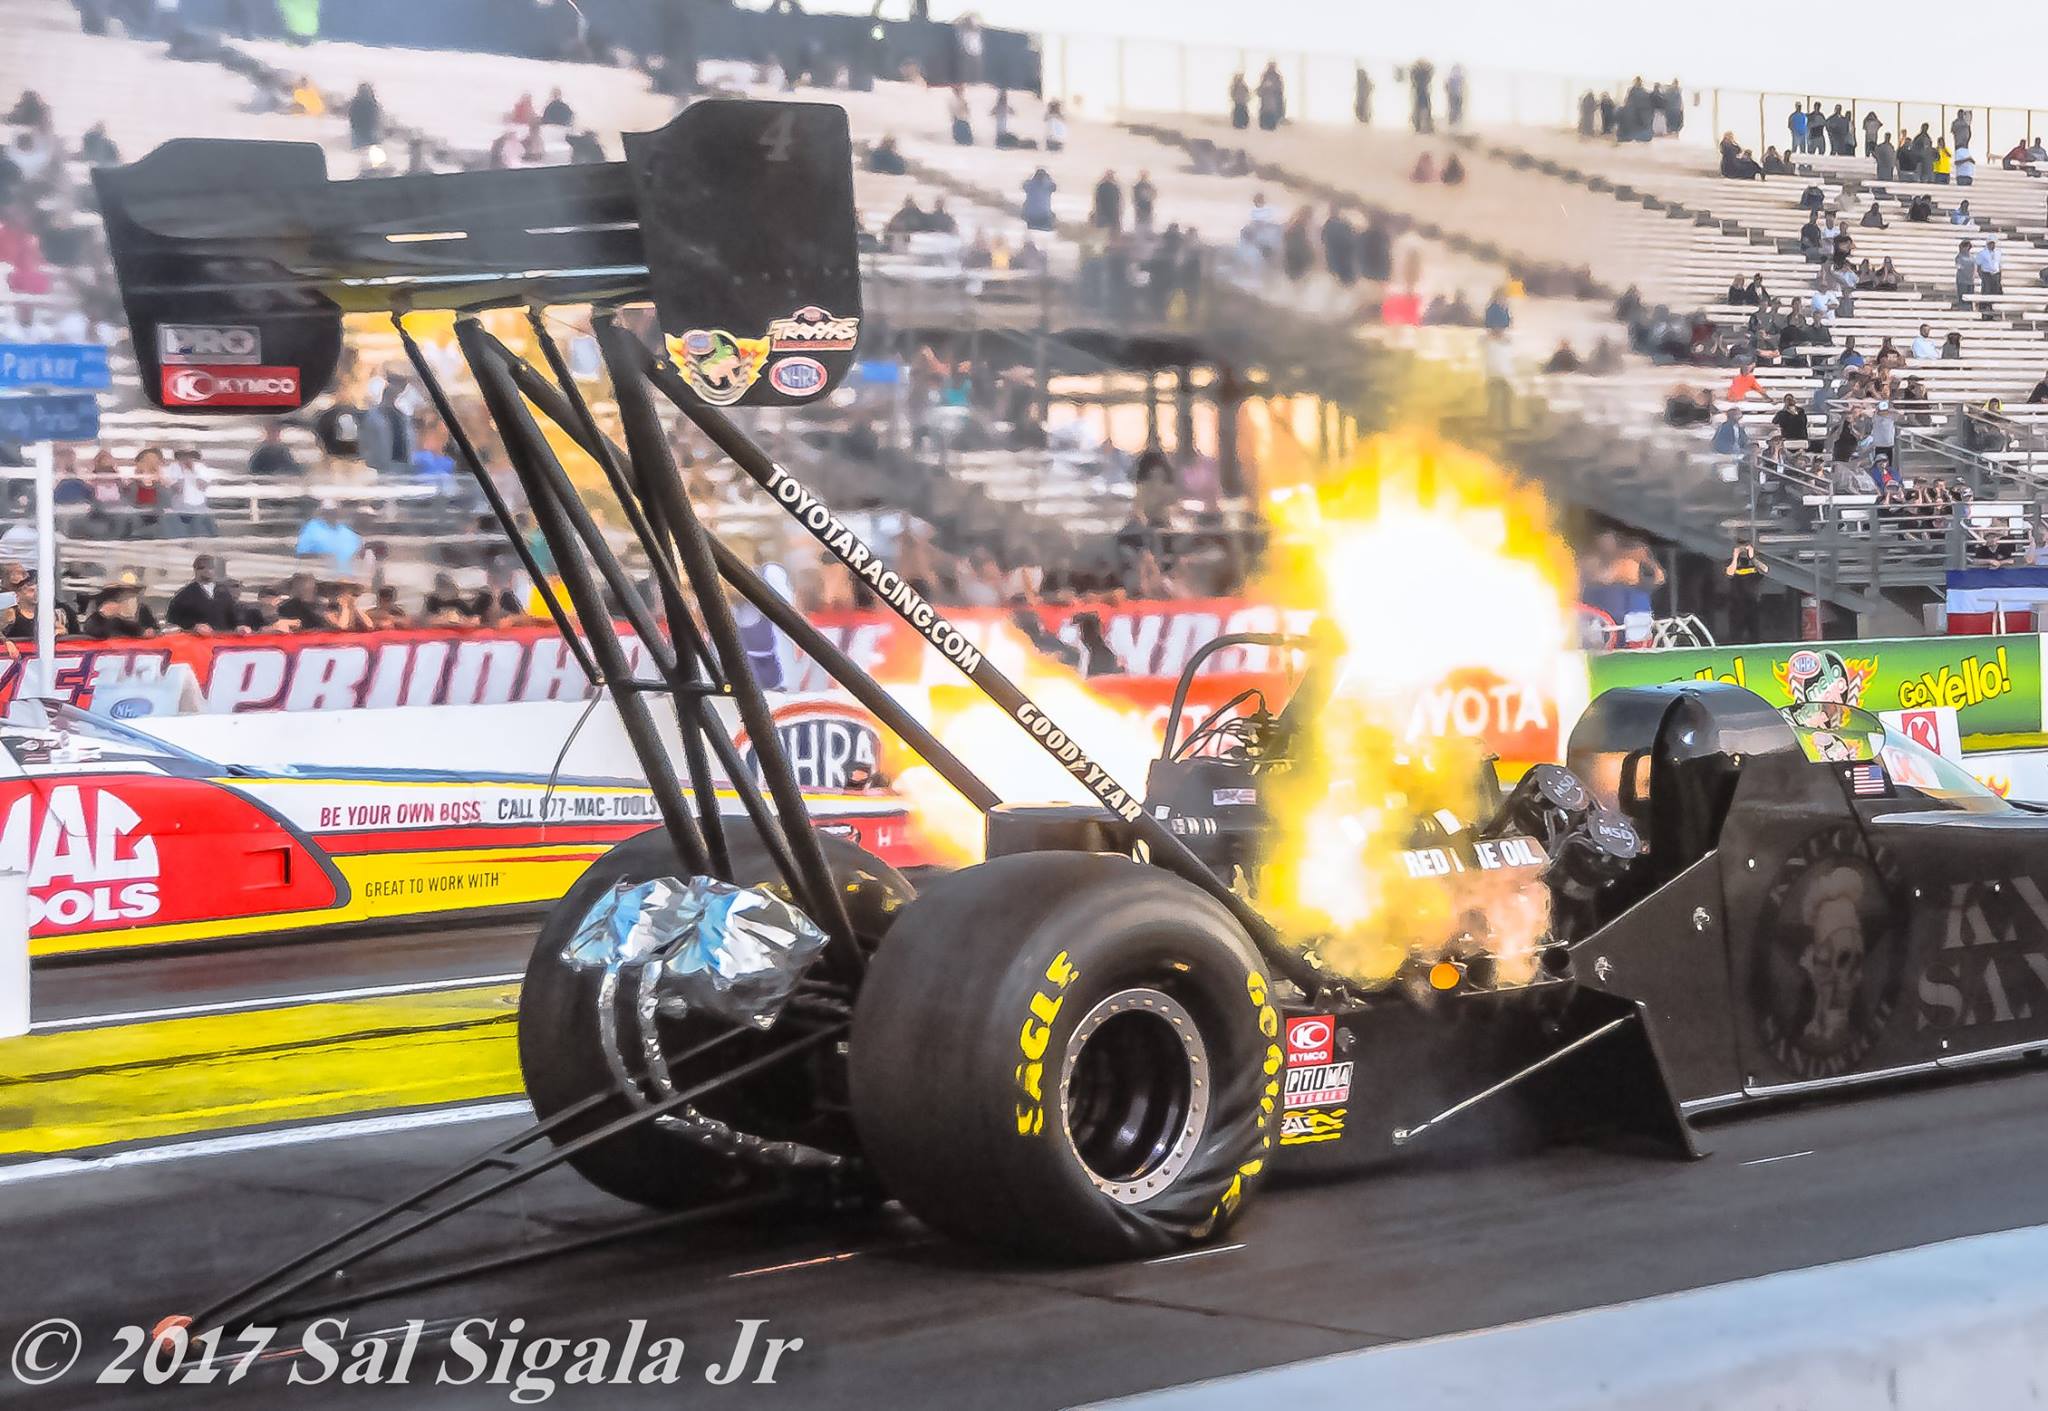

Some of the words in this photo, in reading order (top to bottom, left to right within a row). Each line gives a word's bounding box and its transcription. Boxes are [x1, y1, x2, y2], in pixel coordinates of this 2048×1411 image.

[766, 462, 982, 674] TOYOTARACING.COM
[778, 719, 876, 790] HRA
[1016, 702, 1143, 823] GOODYEAR
[1553, 774, 1575, 798] MSD
[320, 807, 341, 827] BE
[348, 805, 391, 825] YOUR
[397, 803, 434, 824] OWN
[498, 798, 533, 820] CALL
[1600, 826, 1634, 840] MSD
[1499, 840, 1543, 867] OIL
[365, 880, 405, 898] GREAT
[410, 878, 424, 893] TO
[428, 875, 464, 892] WORK
[468, 872, 500, 888] WITH
[1289, 1050, 1328, 1063] KYMCO
[1286, 1064, 1354, 1093] PTIMA
